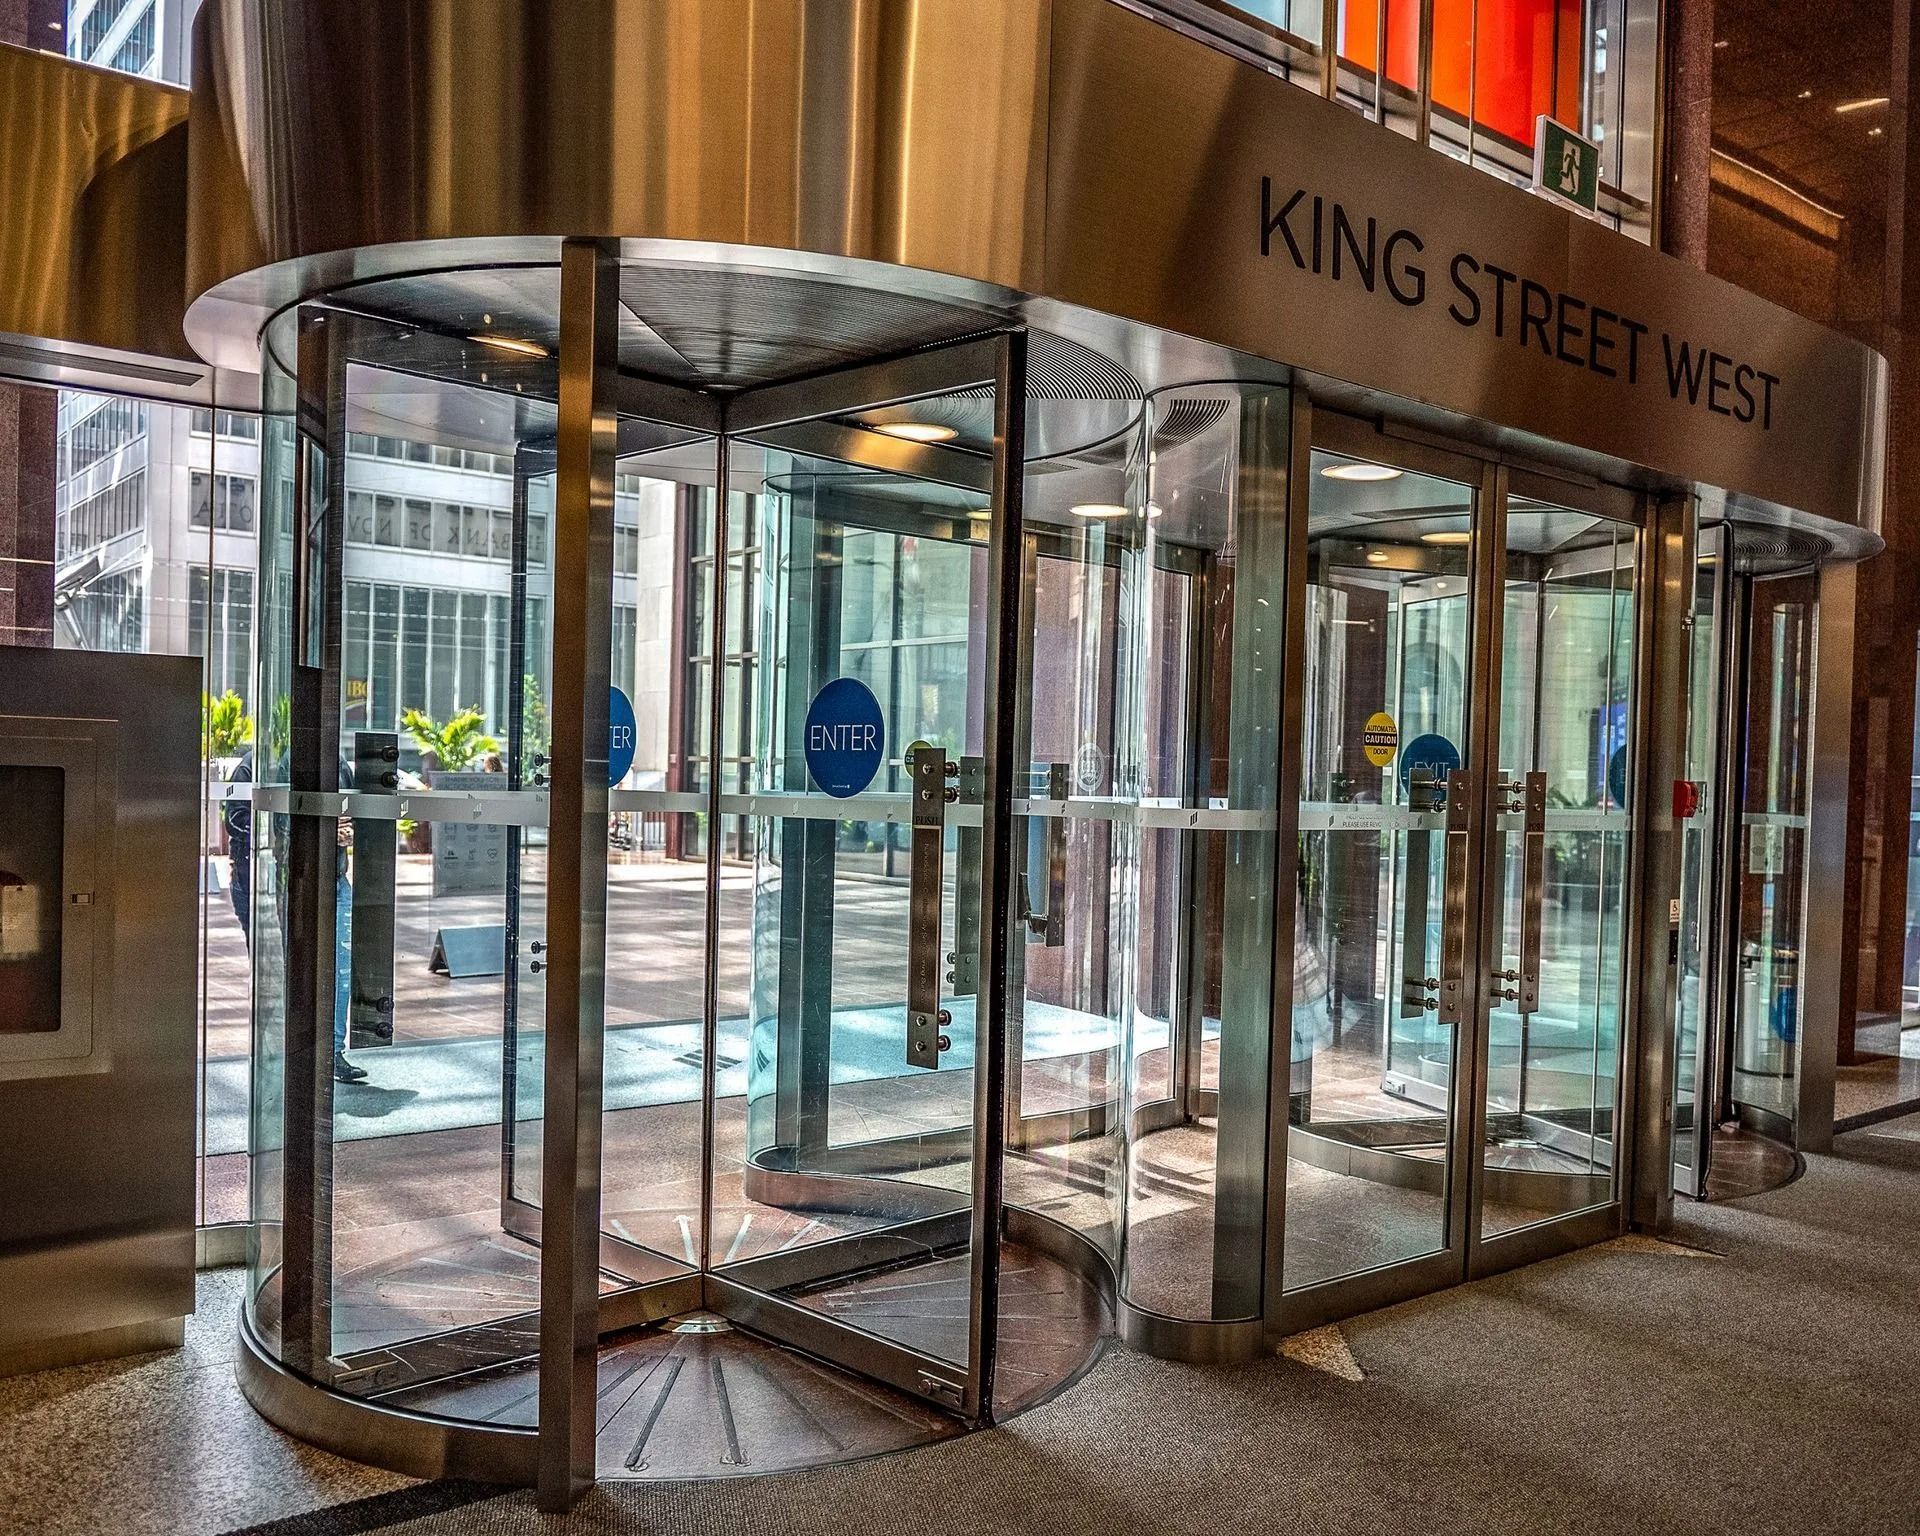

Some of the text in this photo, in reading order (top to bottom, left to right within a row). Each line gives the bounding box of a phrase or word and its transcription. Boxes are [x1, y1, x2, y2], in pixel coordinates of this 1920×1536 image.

[1260, 176, 1780, 430] KING STREET WEST
[810, 724, 877, 751] ENTER
[1365, 734, 1397, 744] CAUTION
[915, 815, 938, 825] PUSH
